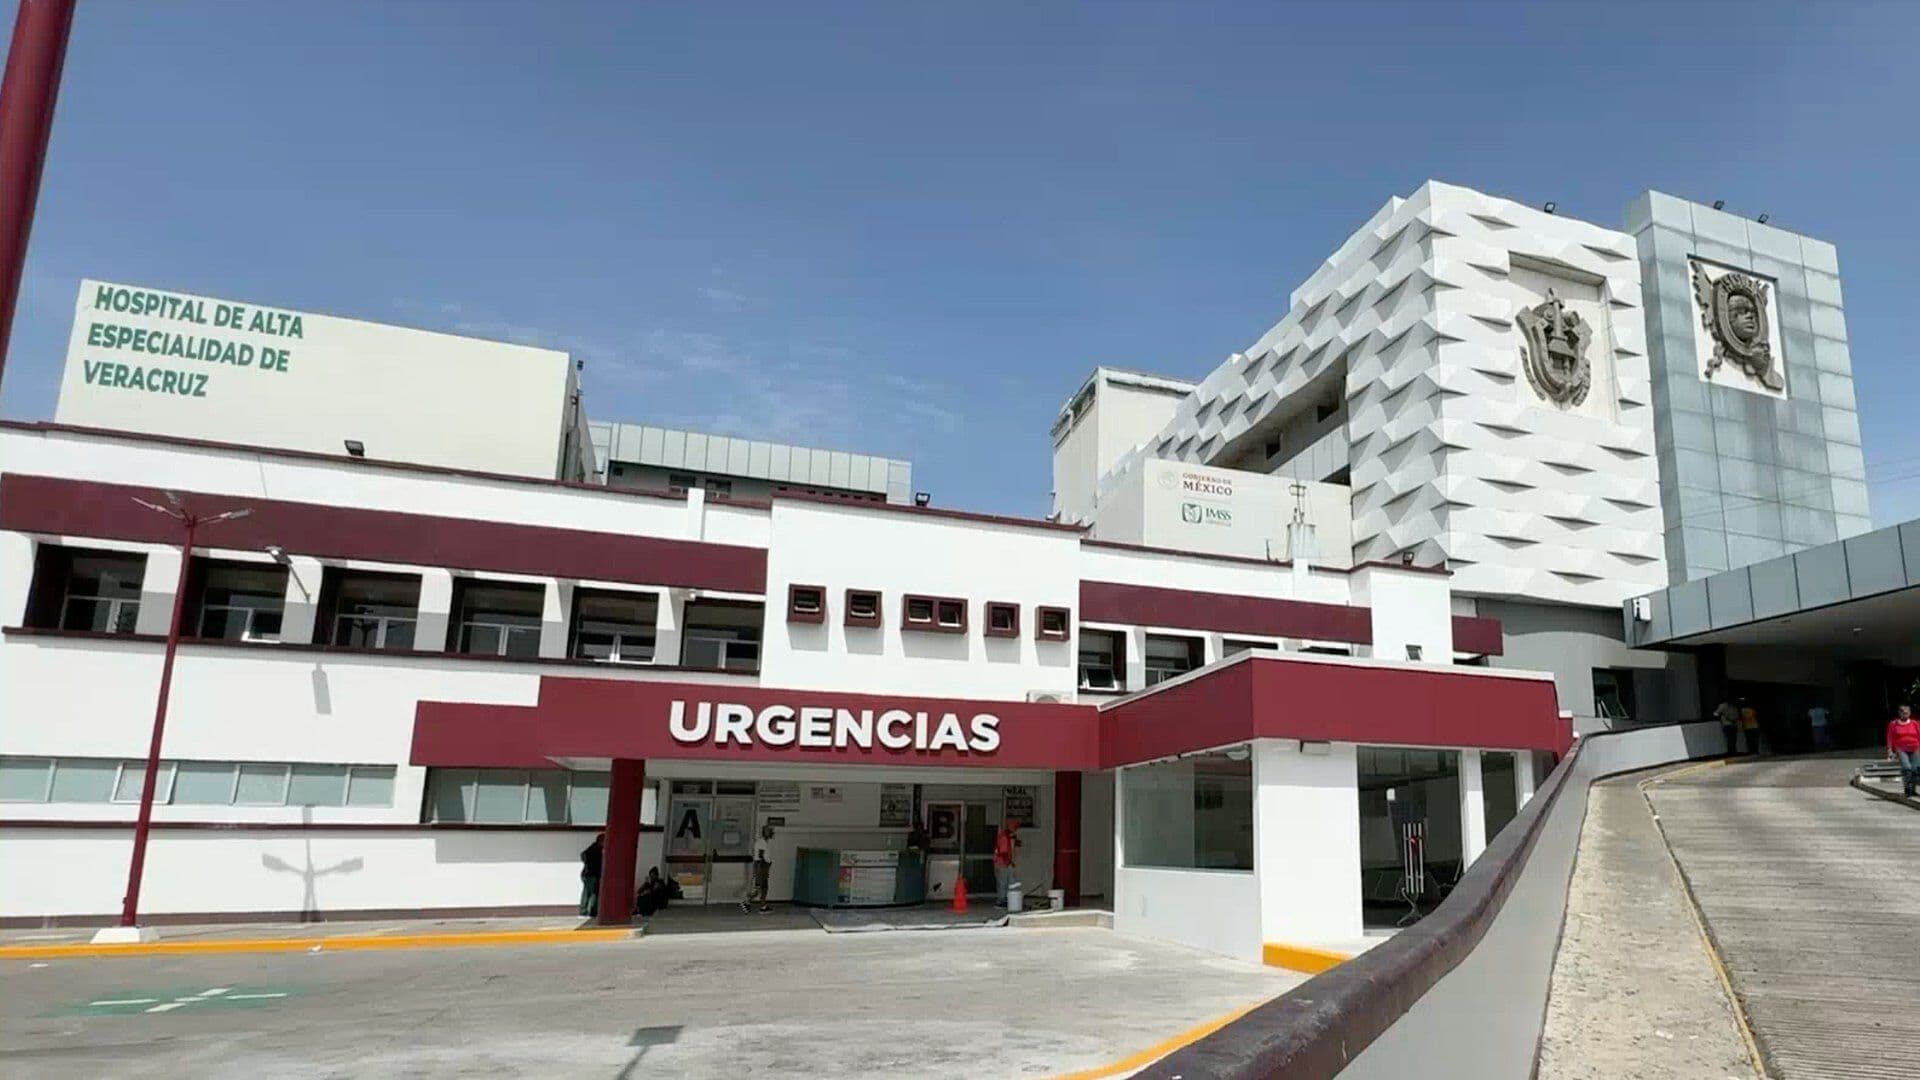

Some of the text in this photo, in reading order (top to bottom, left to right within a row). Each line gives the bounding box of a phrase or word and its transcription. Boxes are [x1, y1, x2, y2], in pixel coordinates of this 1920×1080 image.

[94, 285, 304, 339] HOSPITAL DE ALTA
[87, 322, 291, 373] ESPECIALIDAD DE
[84, 359, 209, 397] VERACRUZ
[1182, 472, 1232, 486] GOBIERNO DE
[1183, 480, 1232, 496] MÉXICO
[1205, 507, 1232, 521] IMSS
[669, 700, 1001, 752] URGENCIAS
[676, 808, 702, 839] A
[931, 811, 956, 840] B
